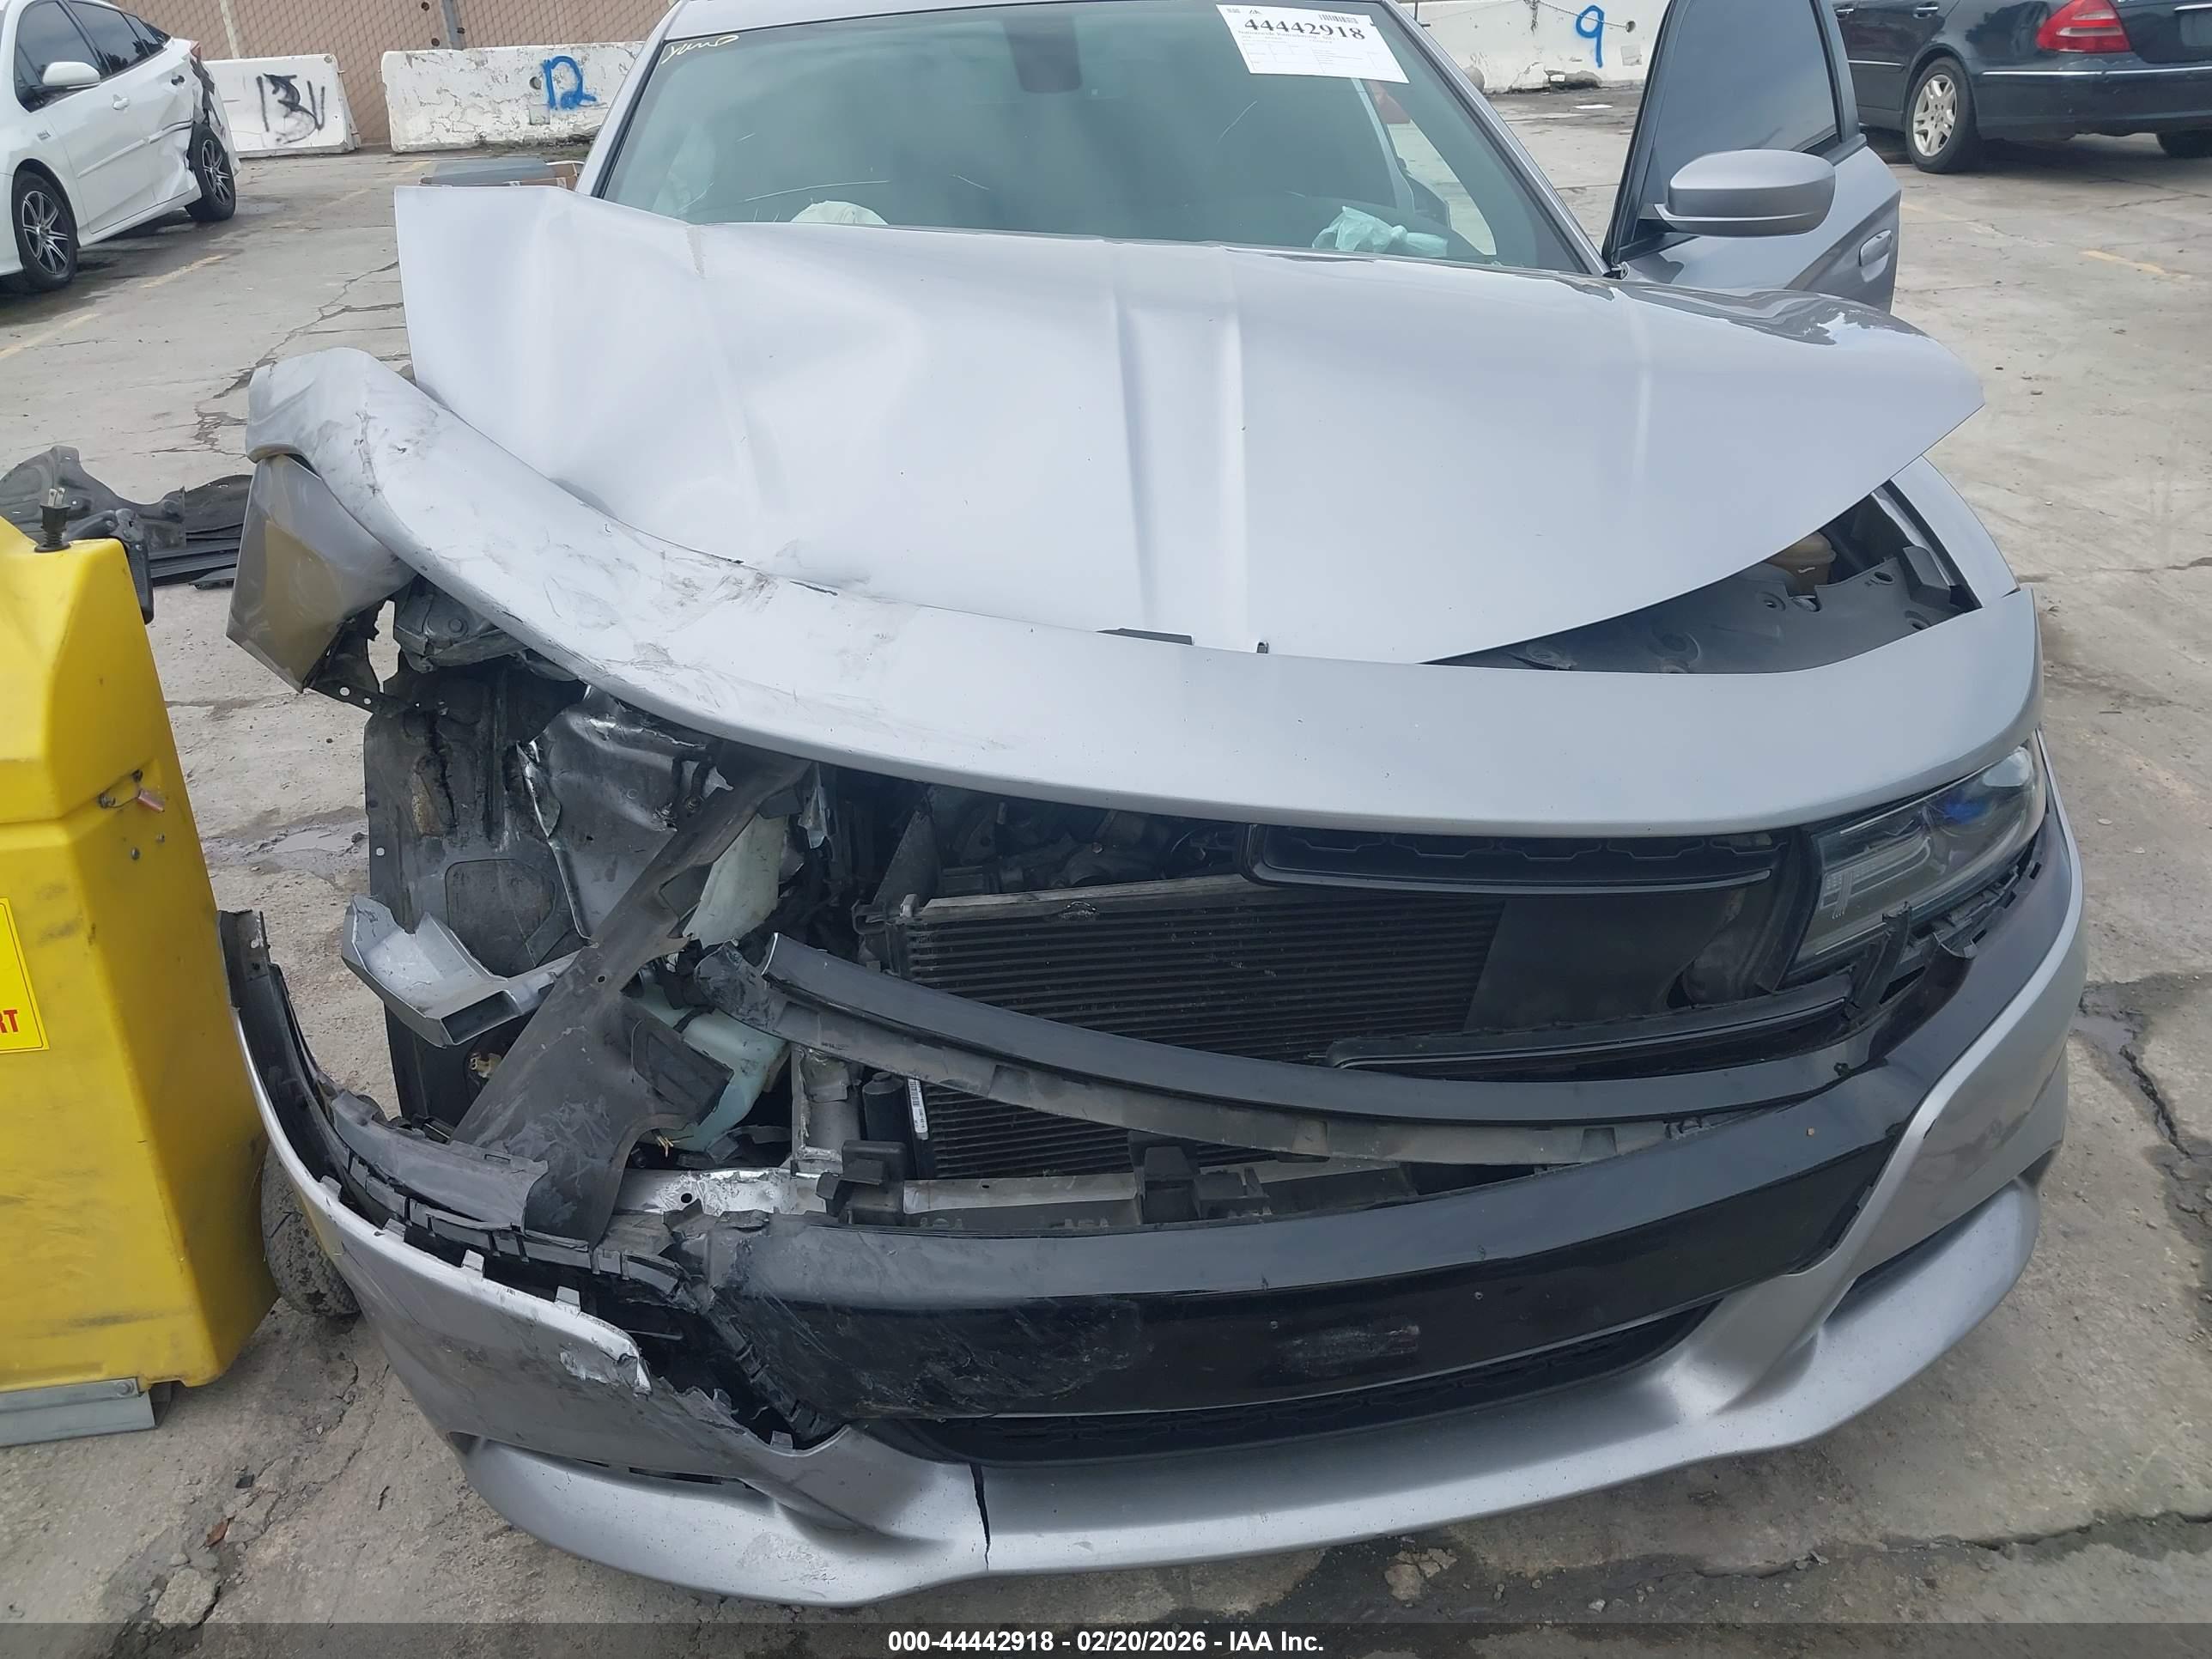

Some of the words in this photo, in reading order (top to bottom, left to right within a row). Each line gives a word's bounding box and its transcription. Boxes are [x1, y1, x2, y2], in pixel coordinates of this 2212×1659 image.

[1244, 18, 1365, 40] 44442918
[1576, 4, 1604, 69] 9
[540, 55, 597, 110] 12
